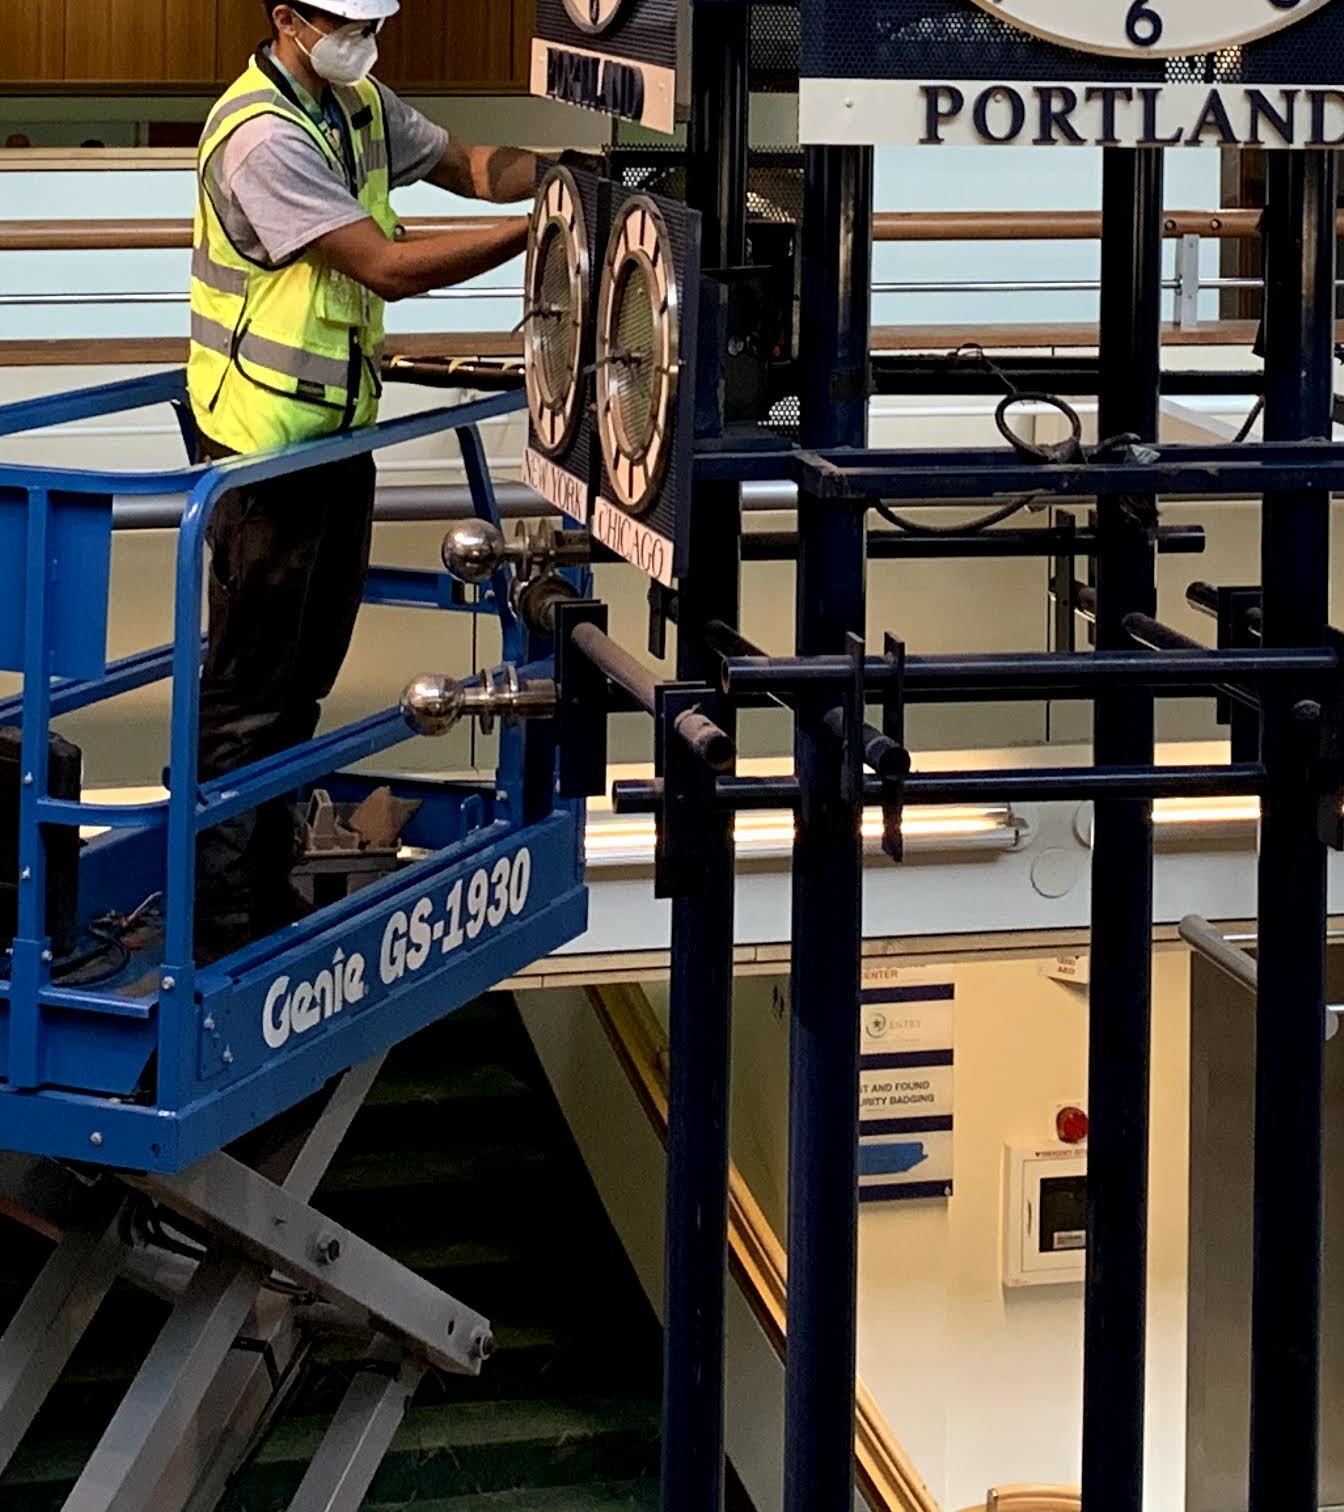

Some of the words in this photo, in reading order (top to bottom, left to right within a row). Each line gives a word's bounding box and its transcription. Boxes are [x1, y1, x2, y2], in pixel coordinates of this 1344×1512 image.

[548, 465, 582, 521] YORK
[598, 502, 664, 578] CHICAGO
[262, 946, 366, 1049] Genie
[379, 846, 532, 985] GS-1930
[871, 1082, 893, 1093] AND
[895, 1080, 930, 1092] FOUND
[889, 1093, 935, 1106] BADGING
